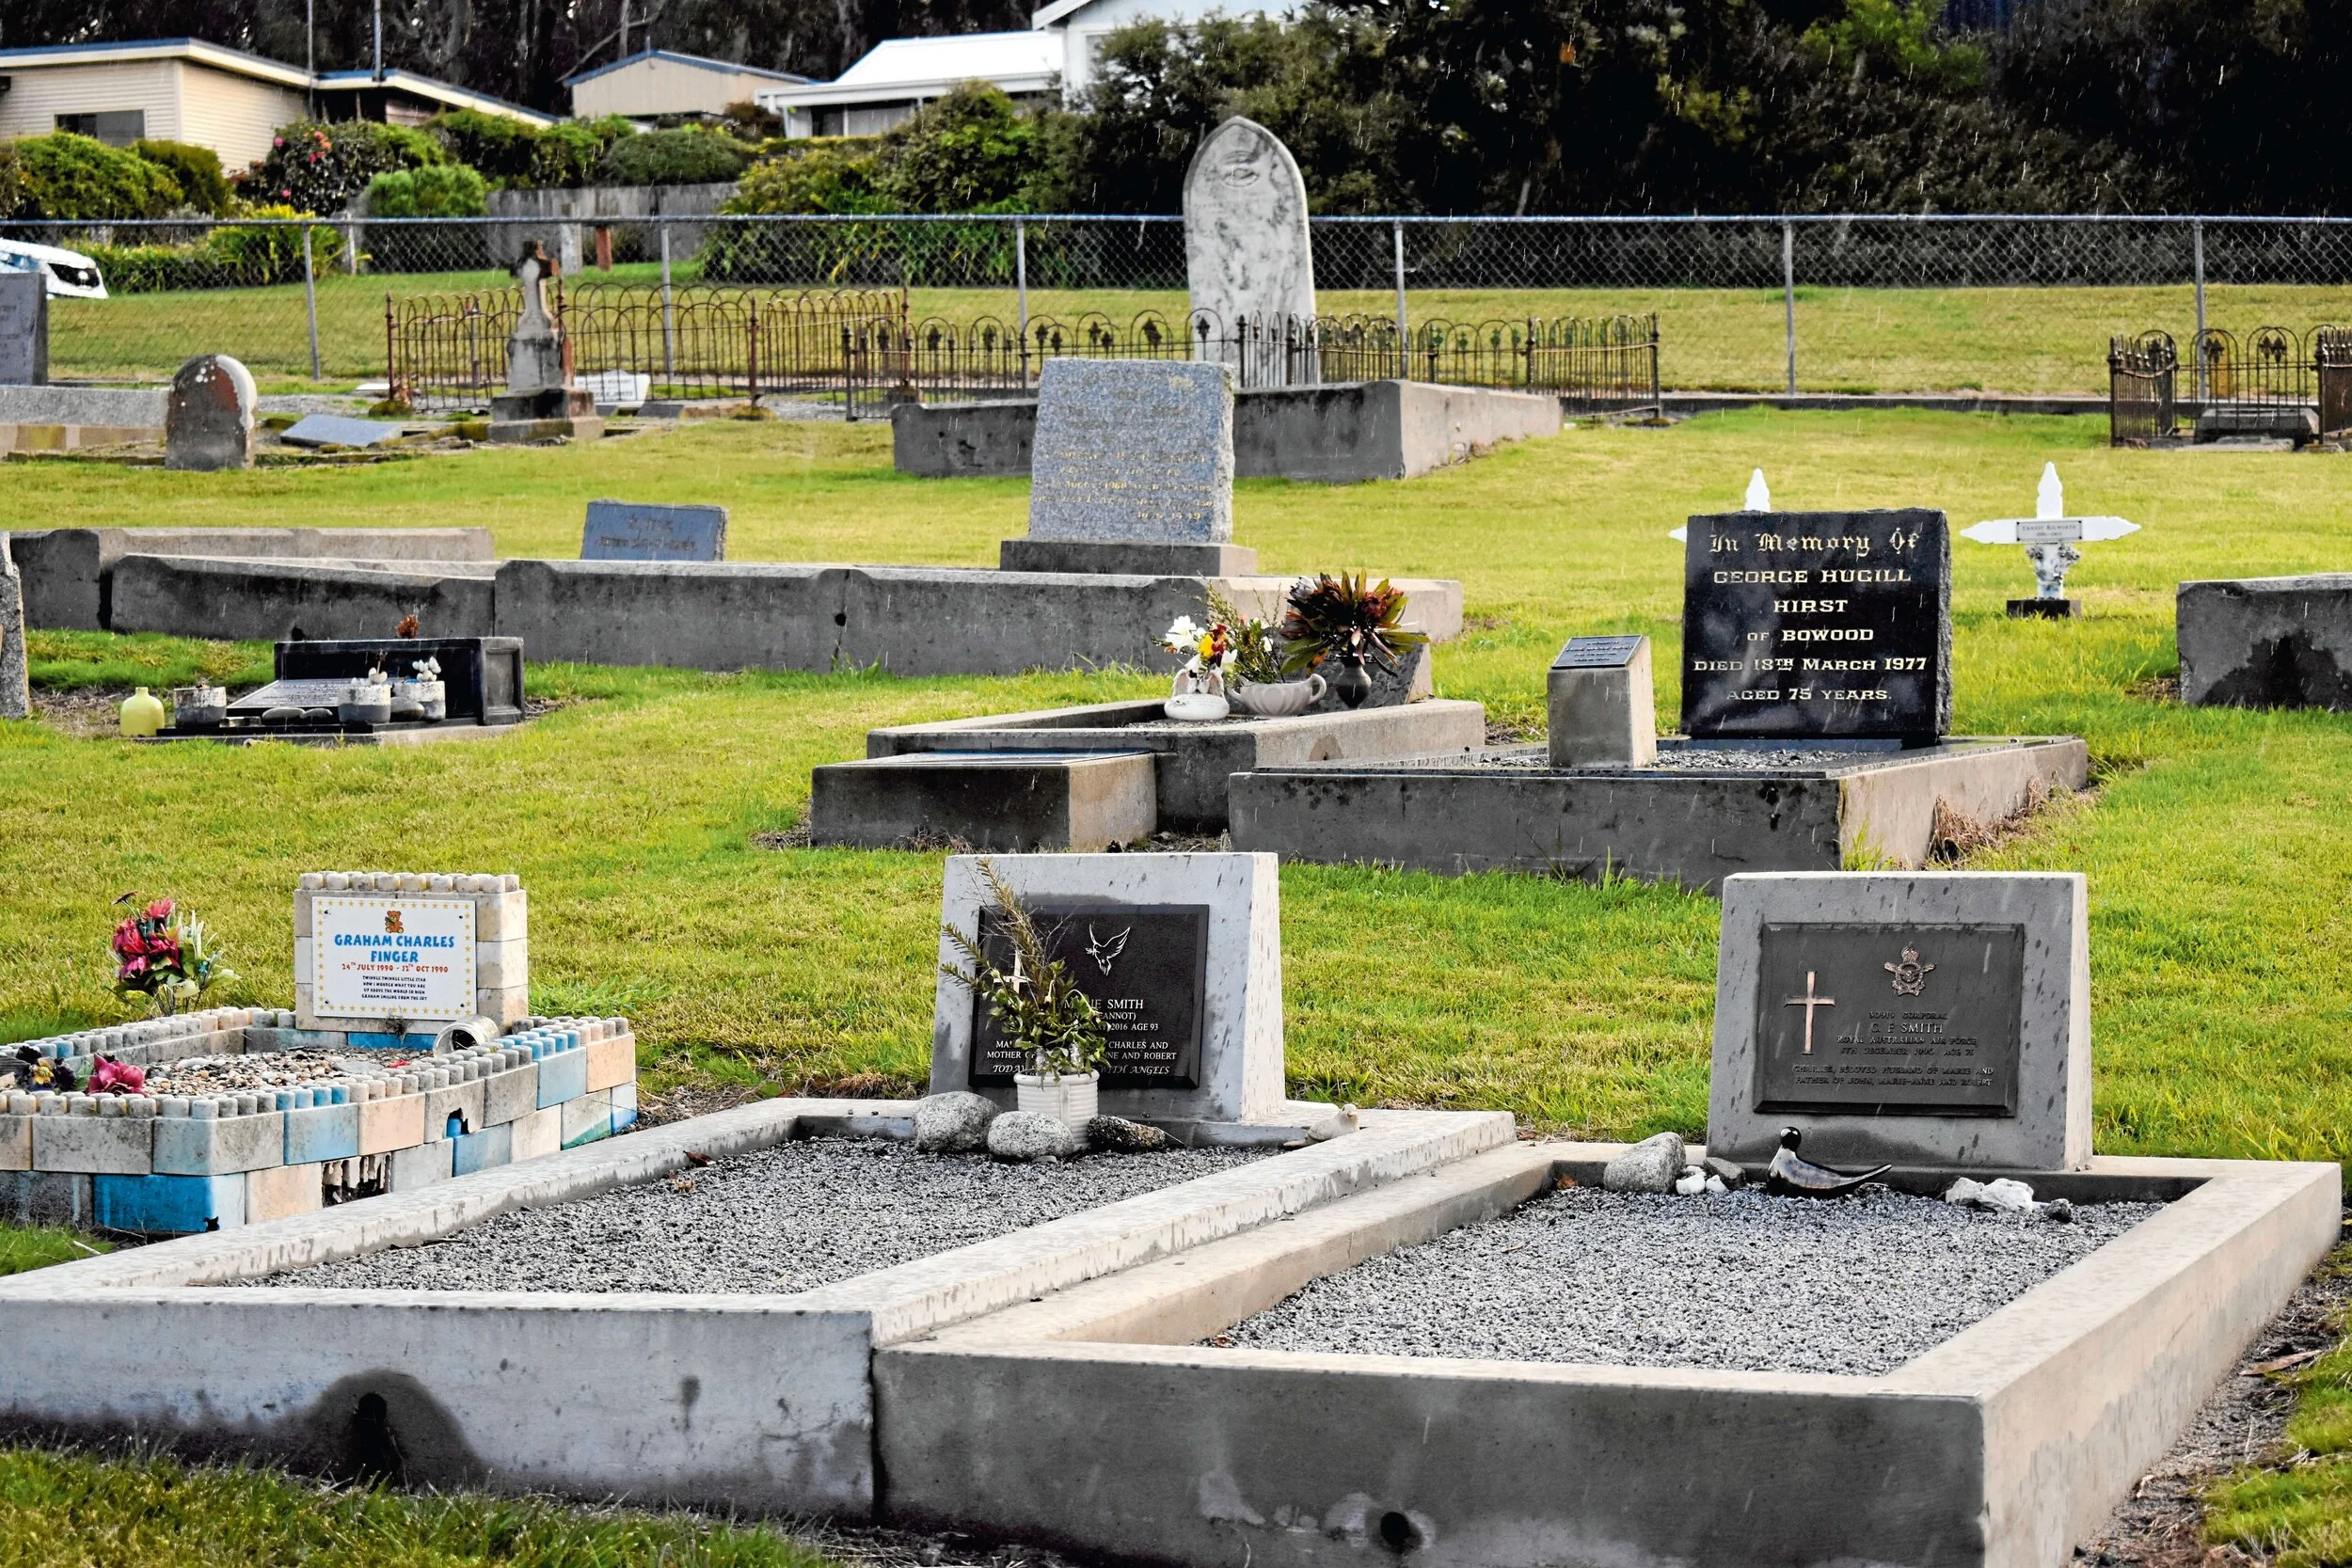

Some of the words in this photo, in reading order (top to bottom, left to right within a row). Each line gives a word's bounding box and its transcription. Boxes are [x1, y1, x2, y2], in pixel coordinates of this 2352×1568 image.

[1708, 531, 1740, 553] In
[1754, 532, 1871, 562] Memory
[1712, 570, 1808, 584] GEORGE
[1820, 568, 1912, 583] HUGILL
[1773, 599, 1849, 613] HIRST
[1746, 632, 1770, 641] OF
[1781, 628, 1875, 641] BOWOOD
[1693, 660, 1744, 672] DIED
[1754, 658, 1795, 672] 18TH
[1802, 657, 1877, 671] MARCH
[1883, 657, 1927, 671] 1977
[1725, 689, 1781, 701] AGED
[1788, 688, 1813, 701] 75
[1820, 689, 1892, 701] YEARS.
[334, 933, 392, 947] GRAHAM
[396, 935, 455, 948] CHARLES
[370, 950, 419, 963] FINGER
[431, 965, 449, 974] 1990
[1064, 999, 1102, 1009] MIE
[1107, 998, 1144, 1009] SMITH
[1902, 1012, 1948, 1021] CORPORAL
[1111, 1022, 1128, 1031] 2016
[1900, 1022, 1944, 1034] SMITH
[1108, 1041, 1147, 1050] CHARLES
[1150, 1041, 1169, 1050] AND
[1836, 1036, 1864, 1045] ROYAL
[1870, 1036, 1925, 1045] AUSTRALIAN
[1931, 1037, 1947, 1045] AIR
[986, 1051, 1022, 1059] MOTHER
[1121, 1052, 1141, 1060] AND
[1144, 1052, 1178, 1061] ROBERT
[1863, 1047, 1909, 1055] DECEMBER
[1130, 1065, 1170, 1075] ANGELS
[1838, 1064, 1877, 1074] BELOVED
[1883, 1065, 1923, 1075] HUSBAND
[1926, 1066, 1939, 1075] OF
[1942, 1067, 1972, 1075] MARIE
[1976, 1067, 1994, 1076] AND
[1795, 1077, 1829, 1085] FATHER
[1938, 1078, 1958, 1087] AND
[1960, 1078, 1993, 1087] ROBERT
